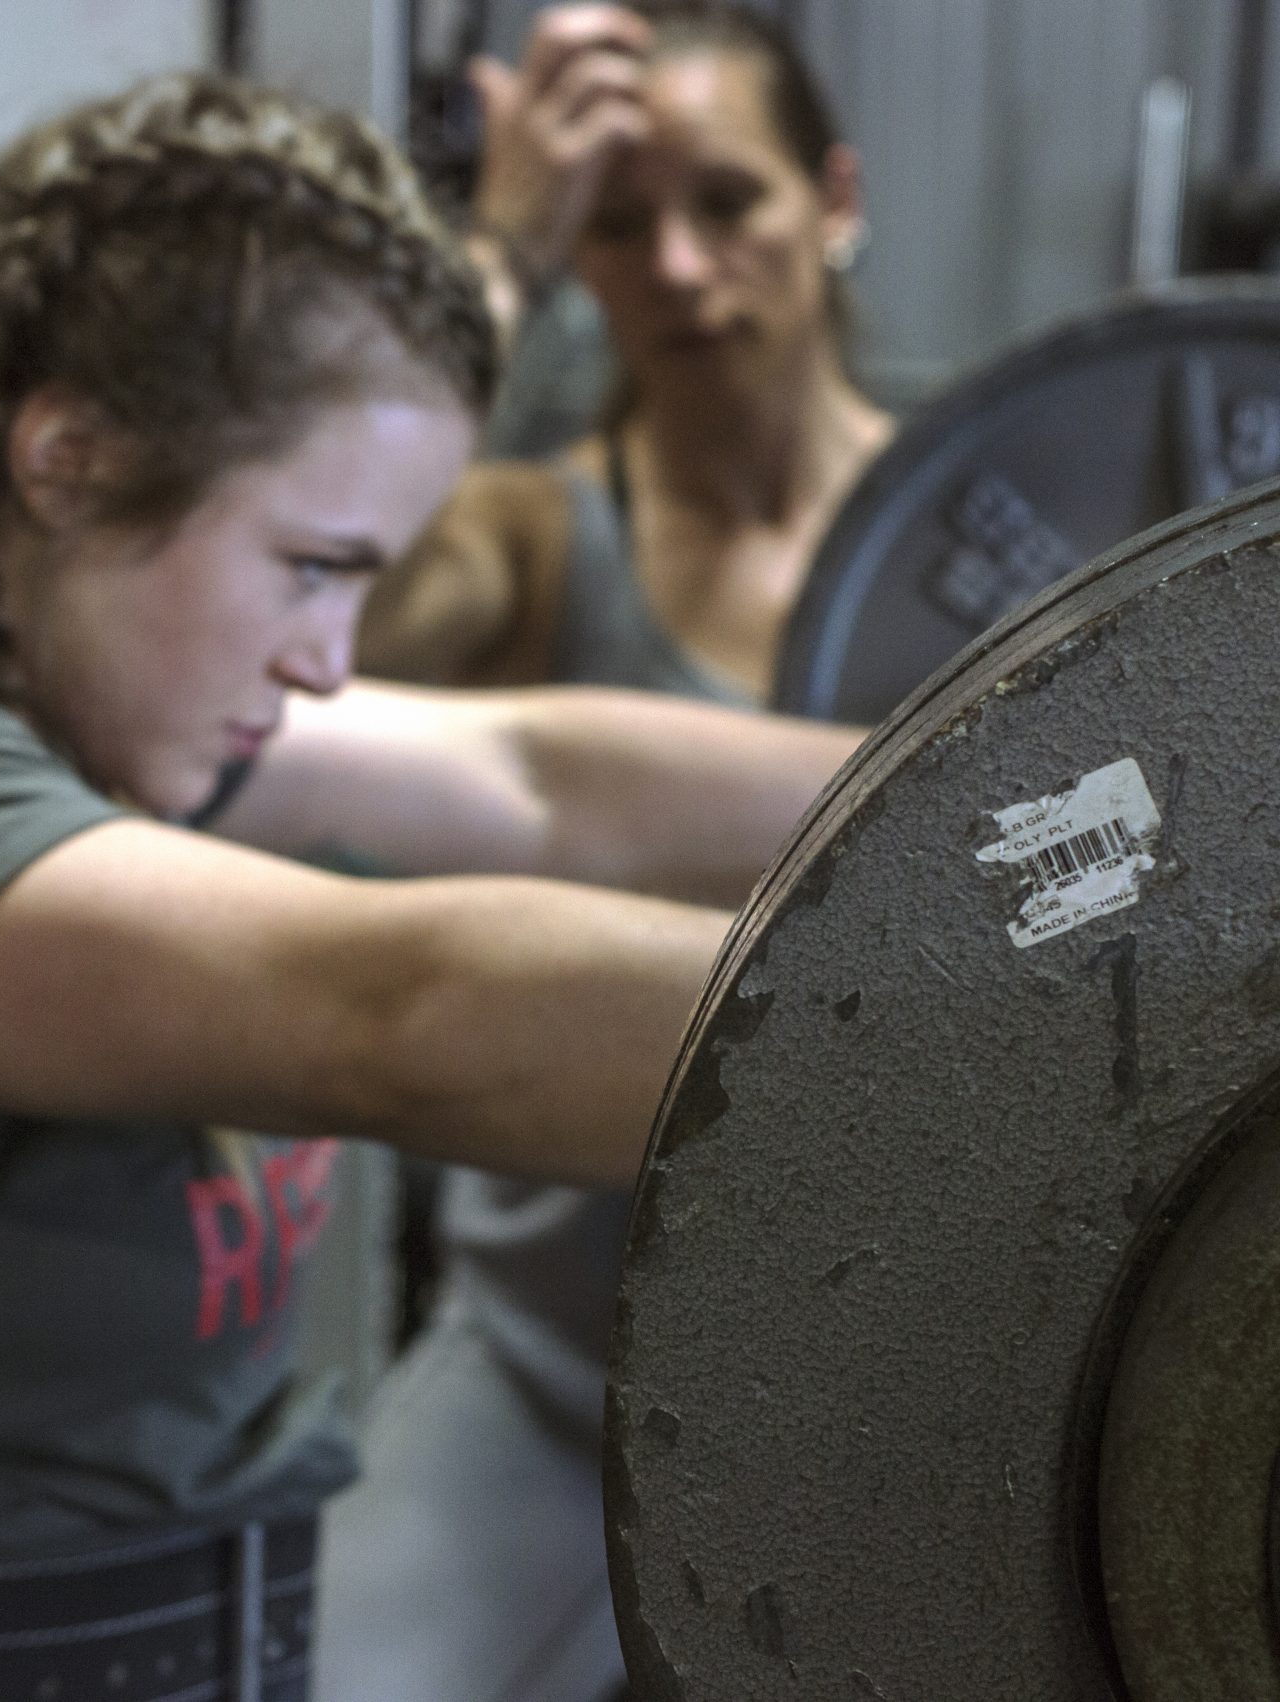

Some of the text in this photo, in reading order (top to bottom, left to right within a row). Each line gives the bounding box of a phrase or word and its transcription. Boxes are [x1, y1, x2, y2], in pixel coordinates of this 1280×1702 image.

[1014, 820, 1074, 851] OLY PLT
[1031, 913, 1070, 937] MADE
[1073, 906, 1087, 919] IN
